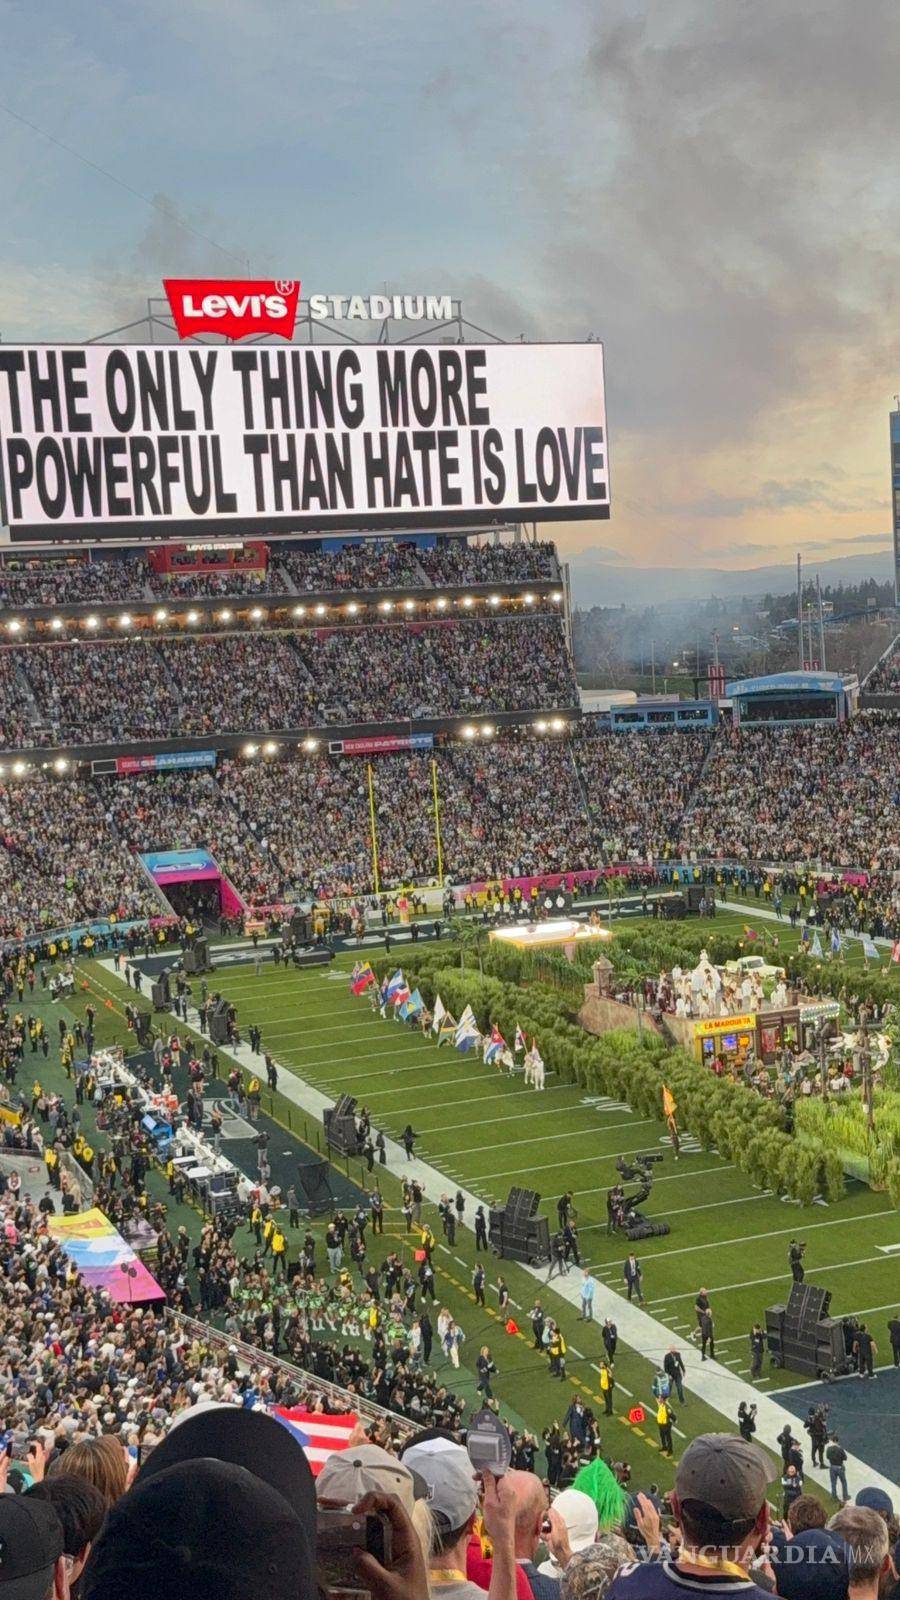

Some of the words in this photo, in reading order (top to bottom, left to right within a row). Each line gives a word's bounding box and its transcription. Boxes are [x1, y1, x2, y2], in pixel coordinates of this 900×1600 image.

[309, 295, 452, 320] STADIUM
[0, 350, 93, 433] THE
[105, 349, 218, 433] ONLY
[232, 348, 365, 430] THING
[376, 348, 490, 427] MORE
[6, 435, 238, 520] POWERFUL
[243, 432, 354, 512] THAN
[363, 430, 462, 508] HATE
[470, 428, 506, 505] IS
[515, 426, 607, 503] LOVE
